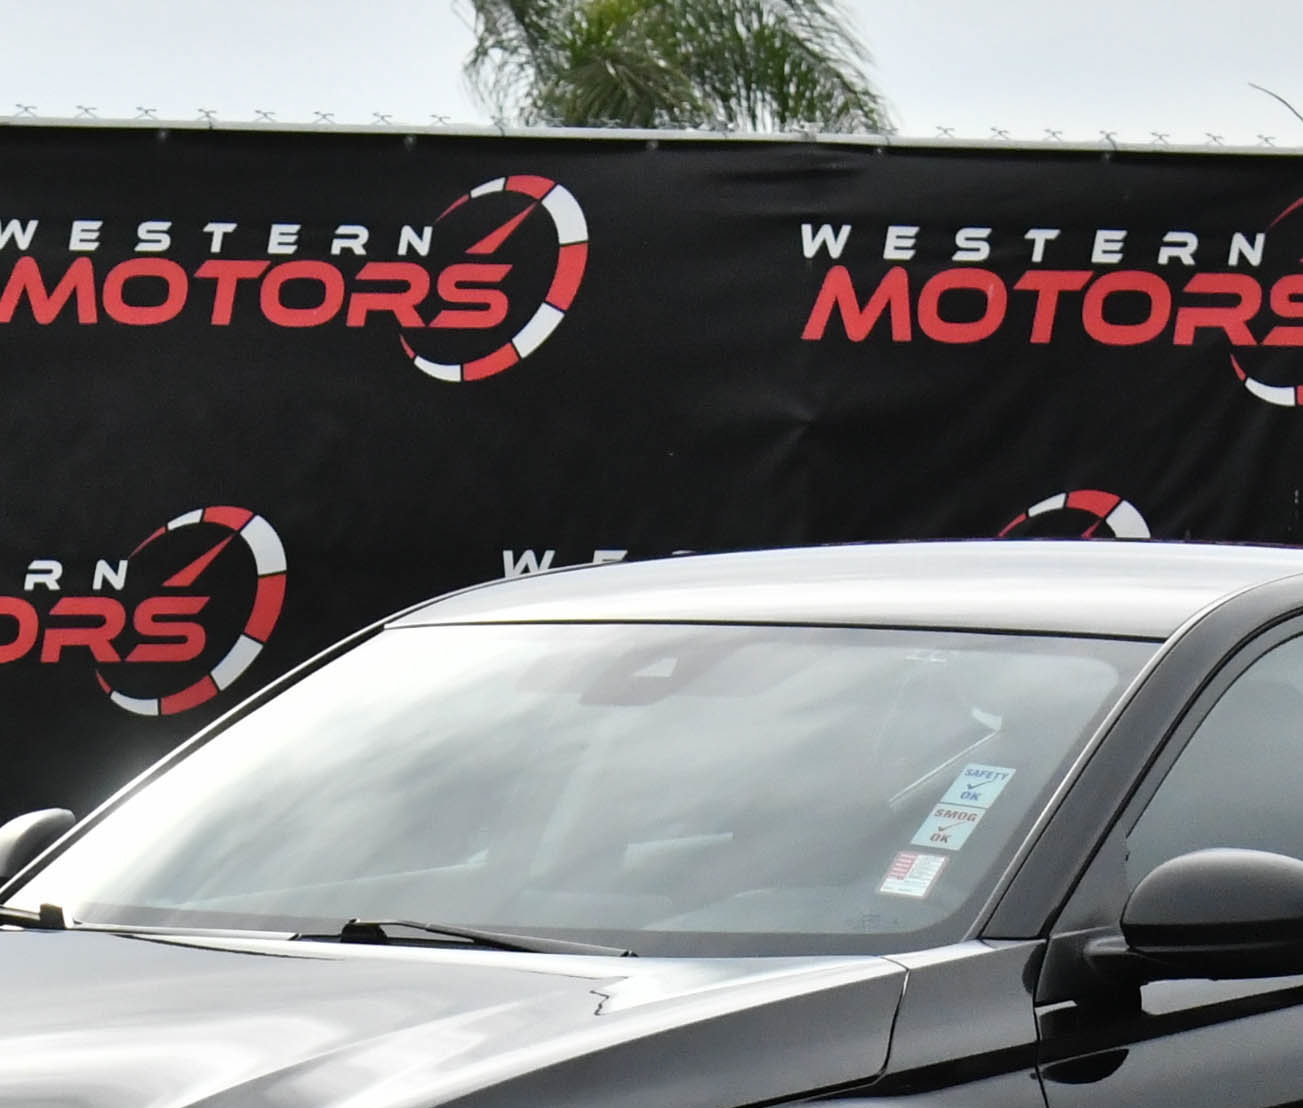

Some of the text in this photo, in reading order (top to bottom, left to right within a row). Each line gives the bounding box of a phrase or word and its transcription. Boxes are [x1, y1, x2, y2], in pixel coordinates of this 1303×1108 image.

[802, 224, 1264, 265] WESTERN
[964, 768, 1010, 780] SAFETY
[960, 791, 982, 801] OK
[934, 809, 978, 822] SMOG
[929, 833, 952, 844] OK
